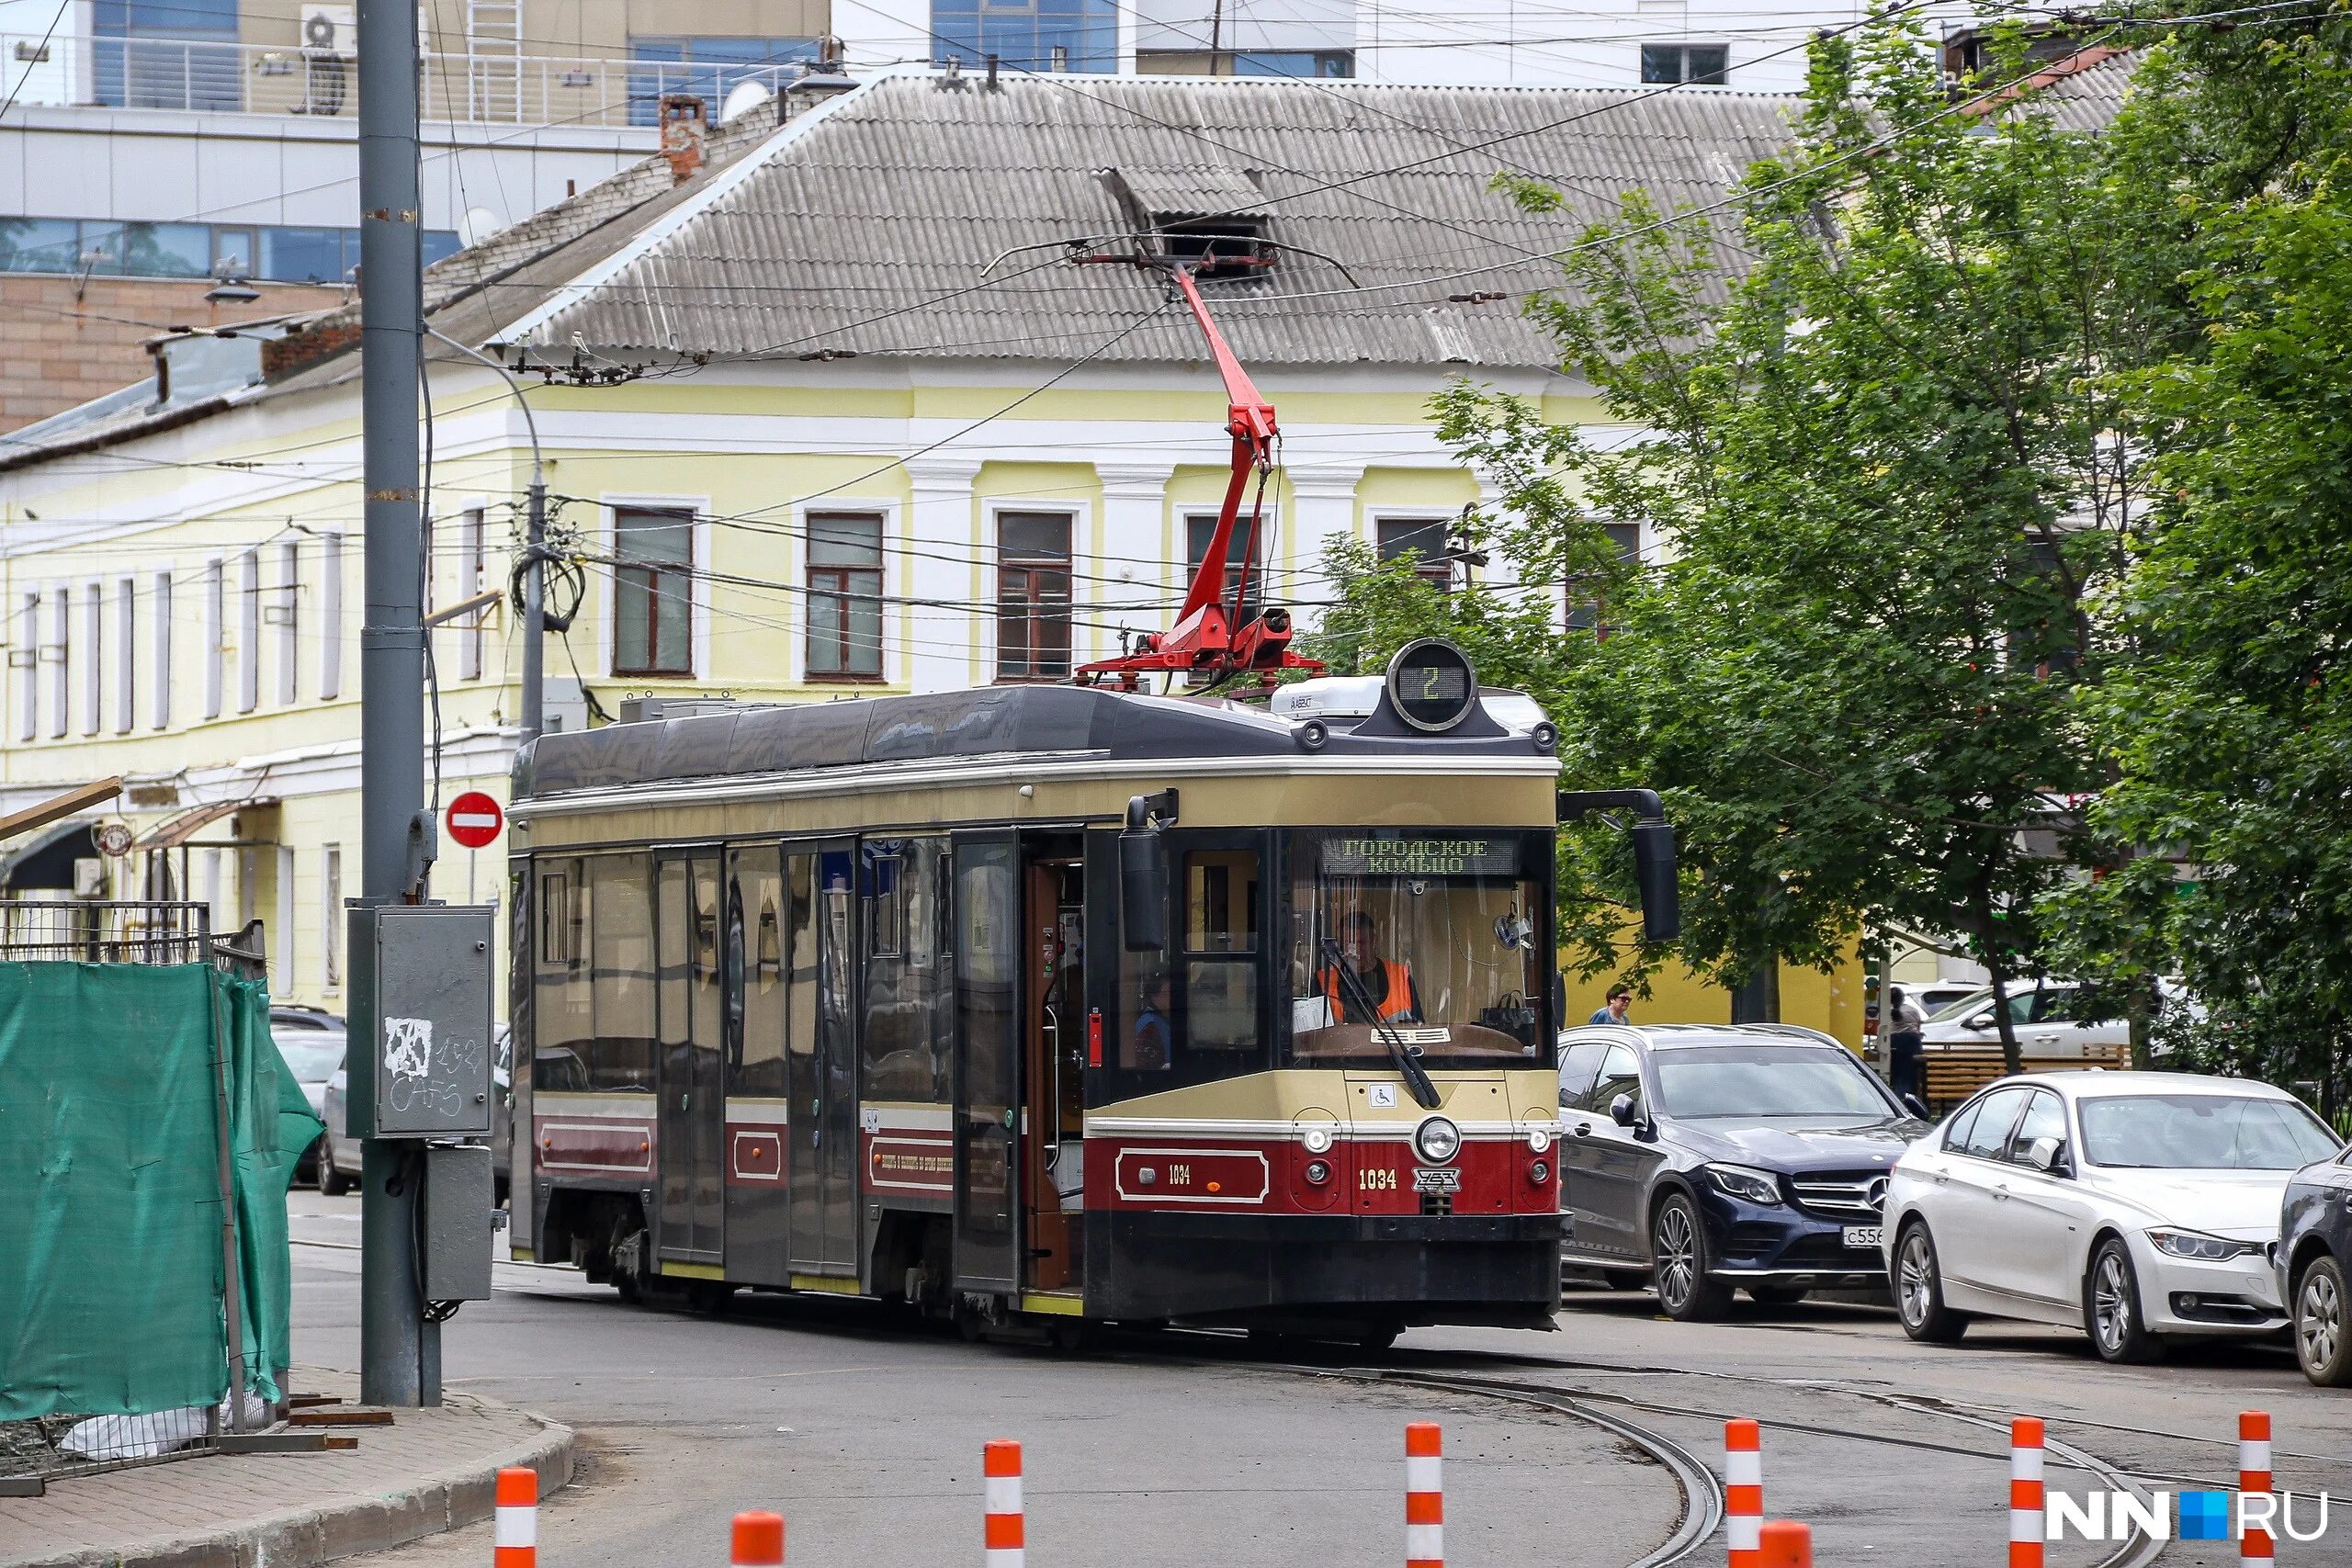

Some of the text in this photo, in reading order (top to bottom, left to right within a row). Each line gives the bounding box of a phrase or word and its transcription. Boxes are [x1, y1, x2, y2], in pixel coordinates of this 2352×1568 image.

[1423, 667, 1439, 700] 2
[1344, 840, 1487, 856] ГОРОДСКОЕ
[1368, 857, 1464, 874] КОЛЬЦО
[1170, 1165, 1191, 1185] 1034
[1359, 1168, 1397, 1190] 1034
